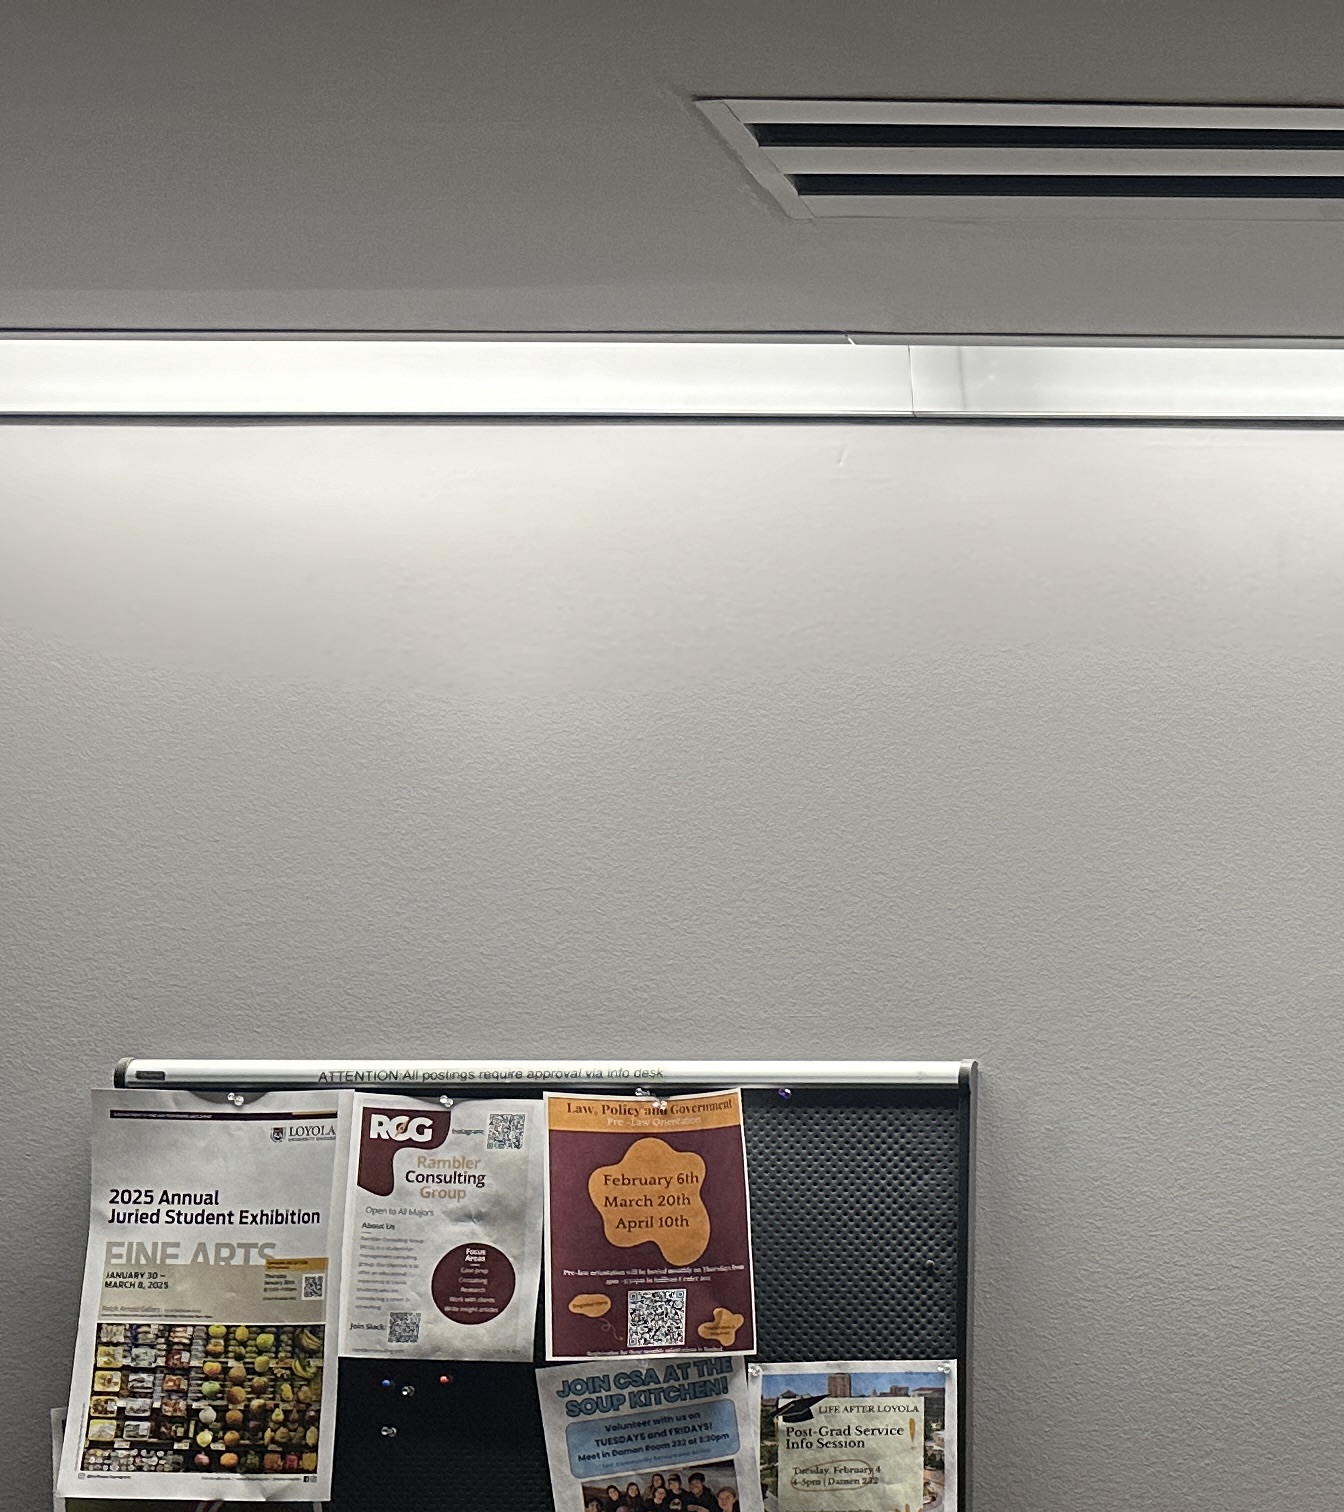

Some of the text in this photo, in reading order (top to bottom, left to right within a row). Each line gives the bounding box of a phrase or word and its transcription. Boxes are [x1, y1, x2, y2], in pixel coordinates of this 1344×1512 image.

[423, 1070, 475, 1083] postings
[479, 1070, 522, 1081] require
[527, 1068, 581, 1081] approval
[586, 1068, 603, 1078] via
[607, 1068, 630, 1078] info
[634, 1068, 664, 1079] desk
[567, 1099, 732, 1117] Law, Policy and Government
[289, 1125, 336, 1136] LOYOLA
[417, 1156, 481, 1169] Rambler
[406, 1171, 486, 1188] Consulting
[604, 1172, 698, 1189] February 6th
[109, 1189, 219, 1205] 2025 Annual
[420, 1187, 466, 1203] Group
[604, 1194, 690, 1207] March 20th
[108, 1208, 320, 1224] Juried Student Exhibition
[366, 1207, 387, 1216] Open
[398, 1207, 407, 1215] All
[409, 1209, 434, 1218] Majors
[616, 1216, 689, 1231] April 10th
[106, 1271, 145, 1279] JANUARY
[105, 1281, 135, 1289] MARCH
[556, 1357, 733, 1397] JOIN CSA AT THE
[566, 1377, 728, 1417] SOUP KITCHEN!
[877, 1405, 919, 1413] LOYOLA
[605, 1419, 650, 1432] Volunteer
[653, 1415, 674, 1426] with
[676, 1413, 687, 1421] us
[595, 1422, 712, 1447] TUESDAYS and FRIDAYS!
[786, 1425, 904, 1437] Post-Grad Service
[786, 1439, 864, 1449] Info Session
